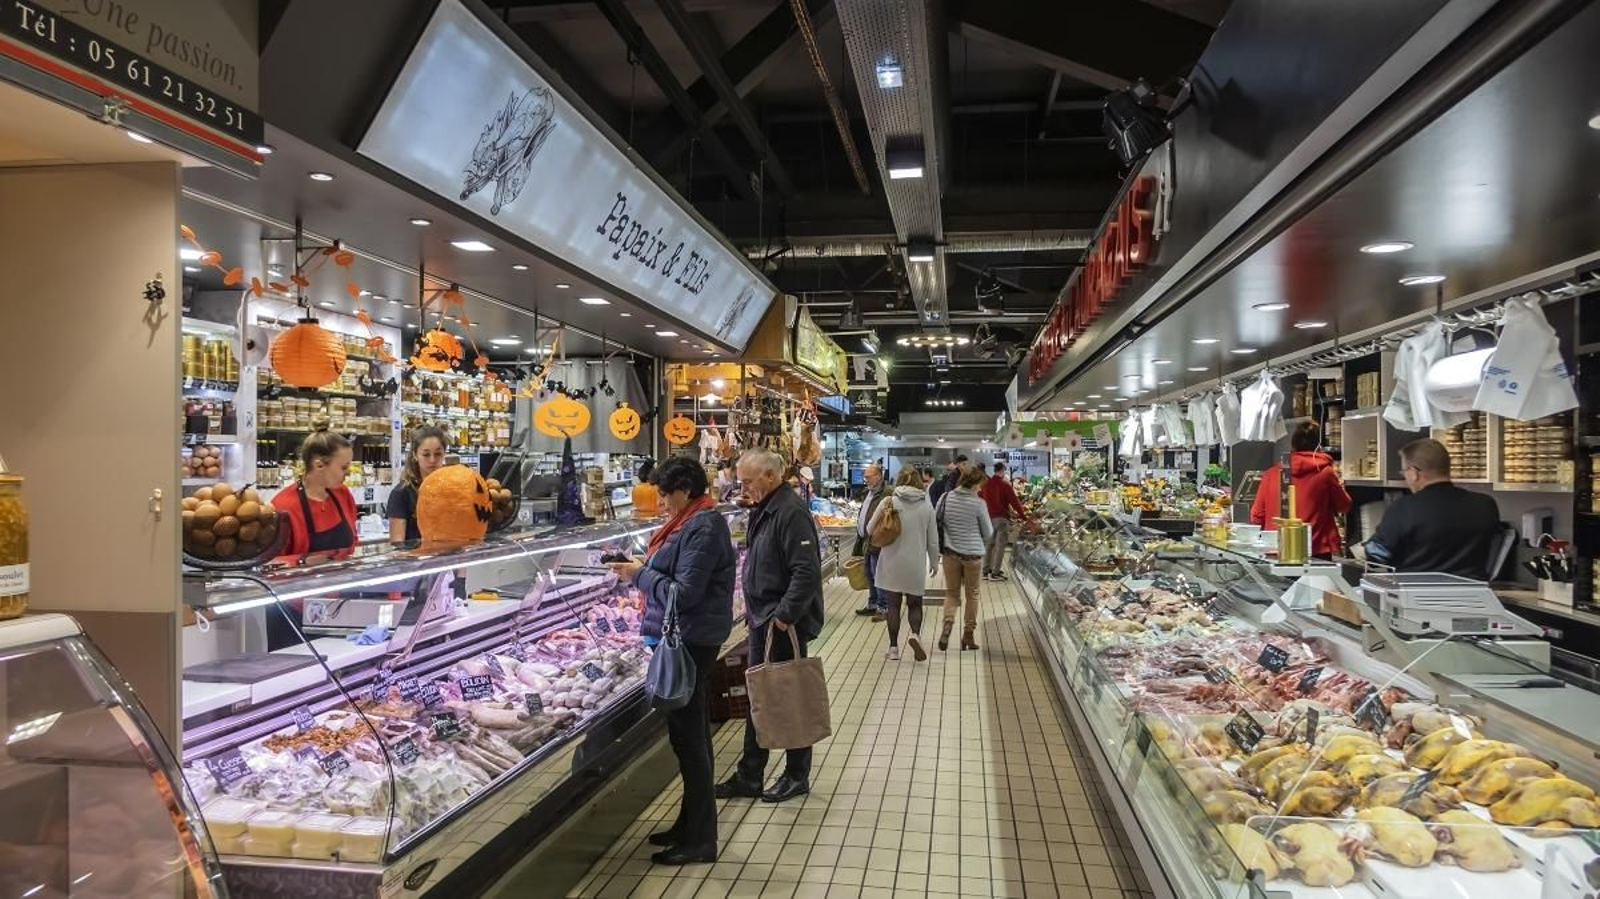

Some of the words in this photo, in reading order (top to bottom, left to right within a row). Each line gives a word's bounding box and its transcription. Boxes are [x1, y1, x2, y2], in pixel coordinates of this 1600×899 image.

[16, 2, 58, 43] Tél
[69, 37, 76, 52] :
[88, 40, 116, 70] 05
[127, 59, 151, 87] 61
[163, 76, 185, 103] 21
[195, 92, 217, 118] 32
[225, 107, 244, 130] 51
[146, 23, 244, 91] passion.
[597, 191, 667, 269] Papaix
[662, 242, 684, 278] &
[675, 250, 711, 295] Fils
